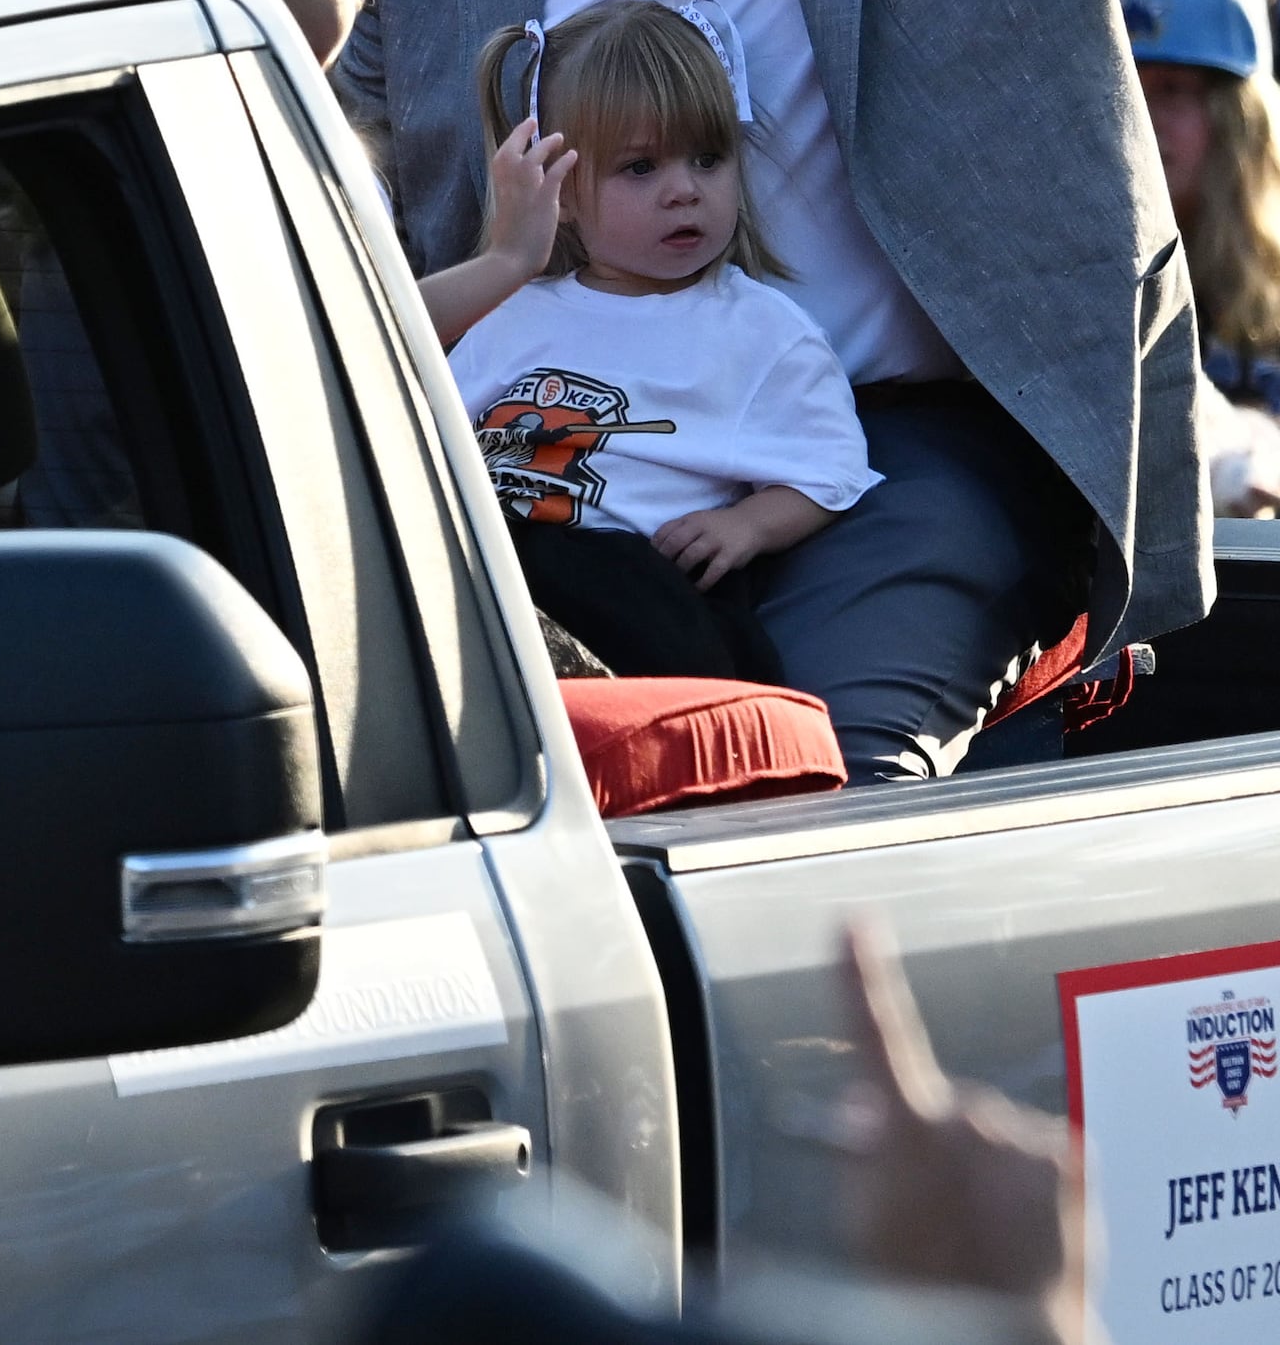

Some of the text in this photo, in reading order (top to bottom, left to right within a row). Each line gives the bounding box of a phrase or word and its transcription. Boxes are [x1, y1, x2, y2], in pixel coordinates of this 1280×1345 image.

[566, 389, 612, 407] KENT
[1187, 1008, 1274, 1043] INDUCTION
[1165, 1171, 1226, 1240] JEFF
[1160, 1269, 1226, 1314] CLASS
[1231, 1265, 1257, 1303] OF
